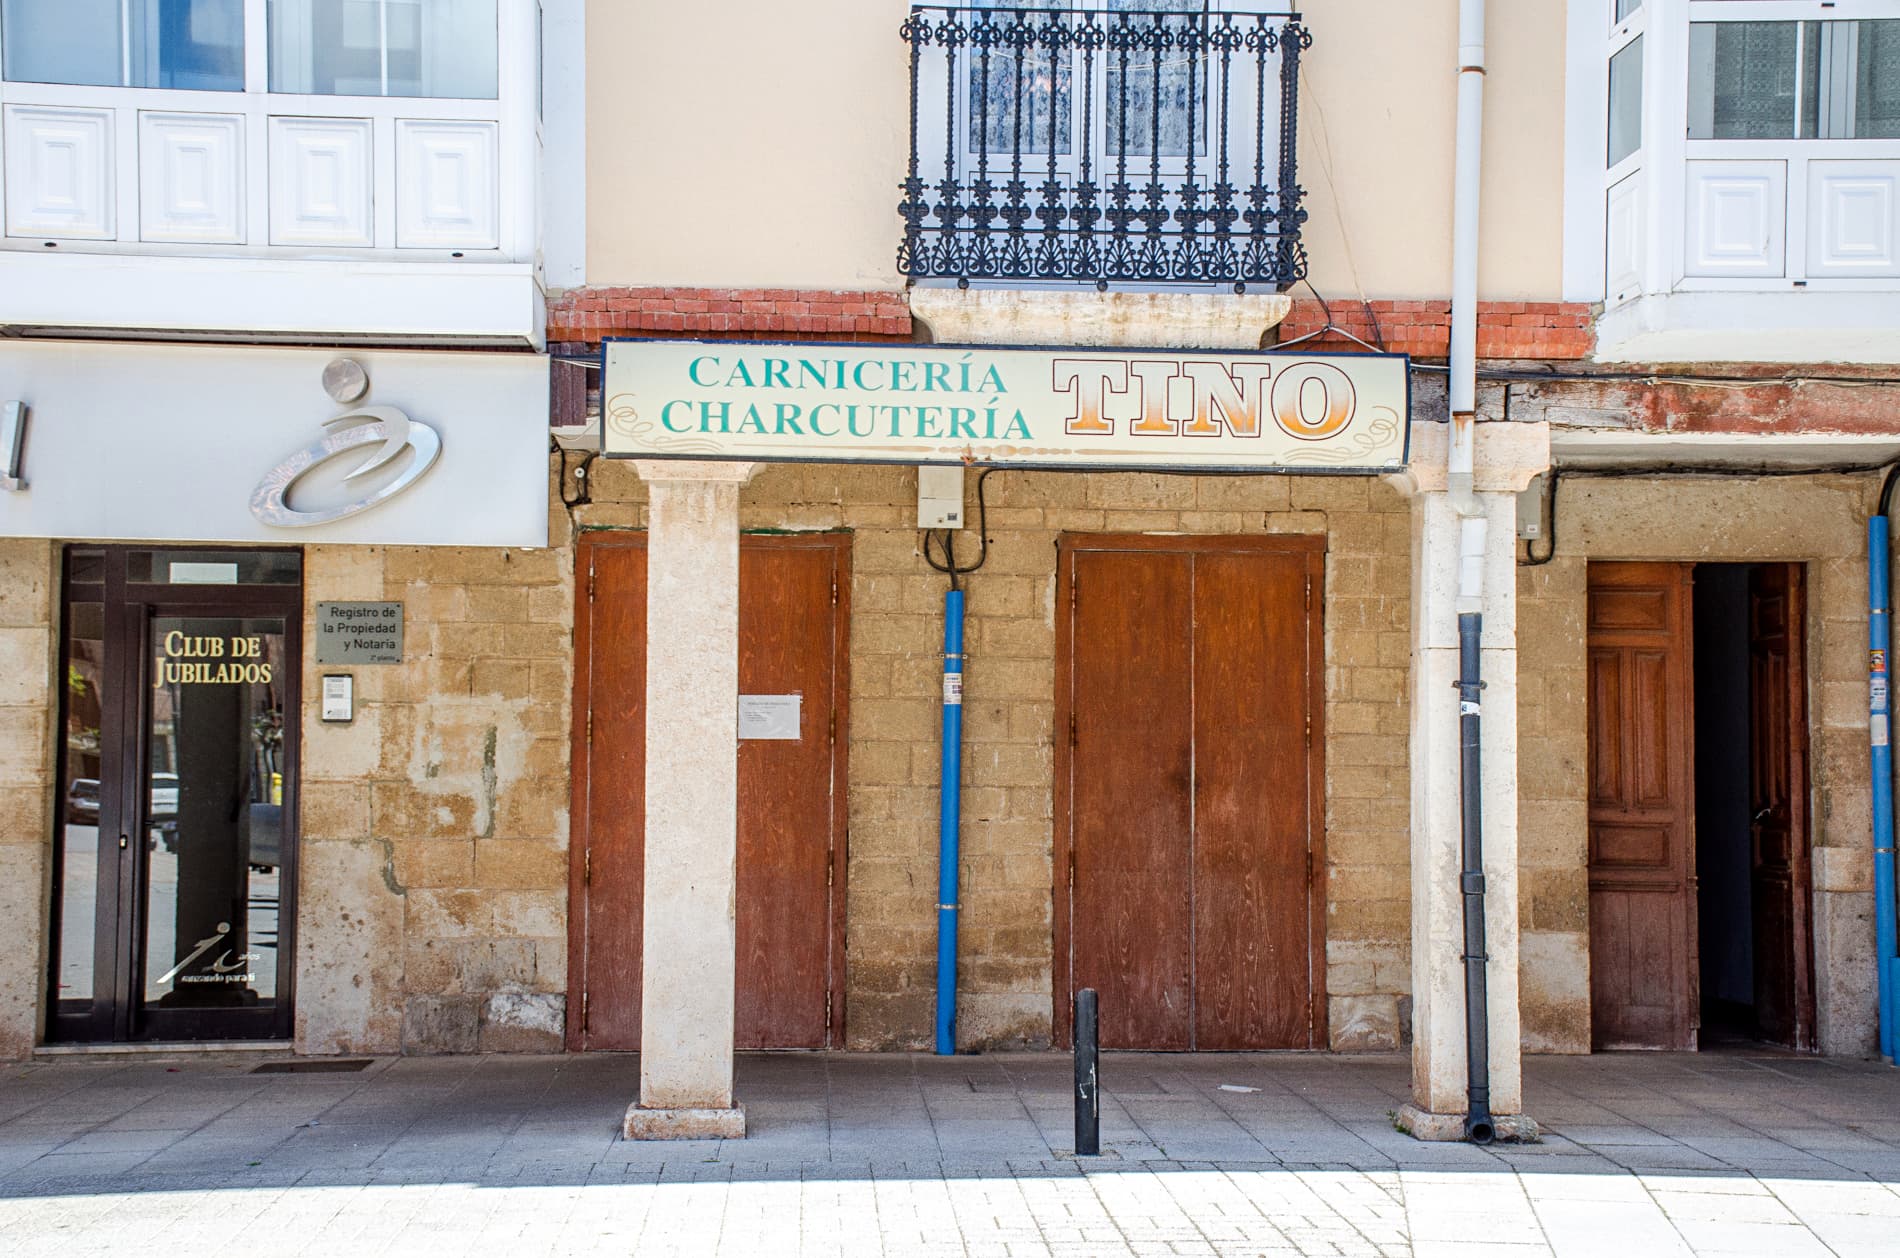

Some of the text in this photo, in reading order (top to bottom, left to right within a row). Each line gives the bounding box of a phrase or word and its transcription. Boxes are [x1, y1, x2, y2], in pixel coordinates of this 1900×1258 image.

[689, 352, 1008, 393] CARNICERÍA
[1052, 359, 1357, 441] TINO
[661, 397, 1034, 440] CHARCUTERÍA
[331, 606, 396, 620] Registro de
[323, 622, 396, 635] la Propiedad
[165, 630, 261, 657] CLUB DE
[344, 641, 351, 652] y
[152, 657, 272, 688] JUBILADOS
